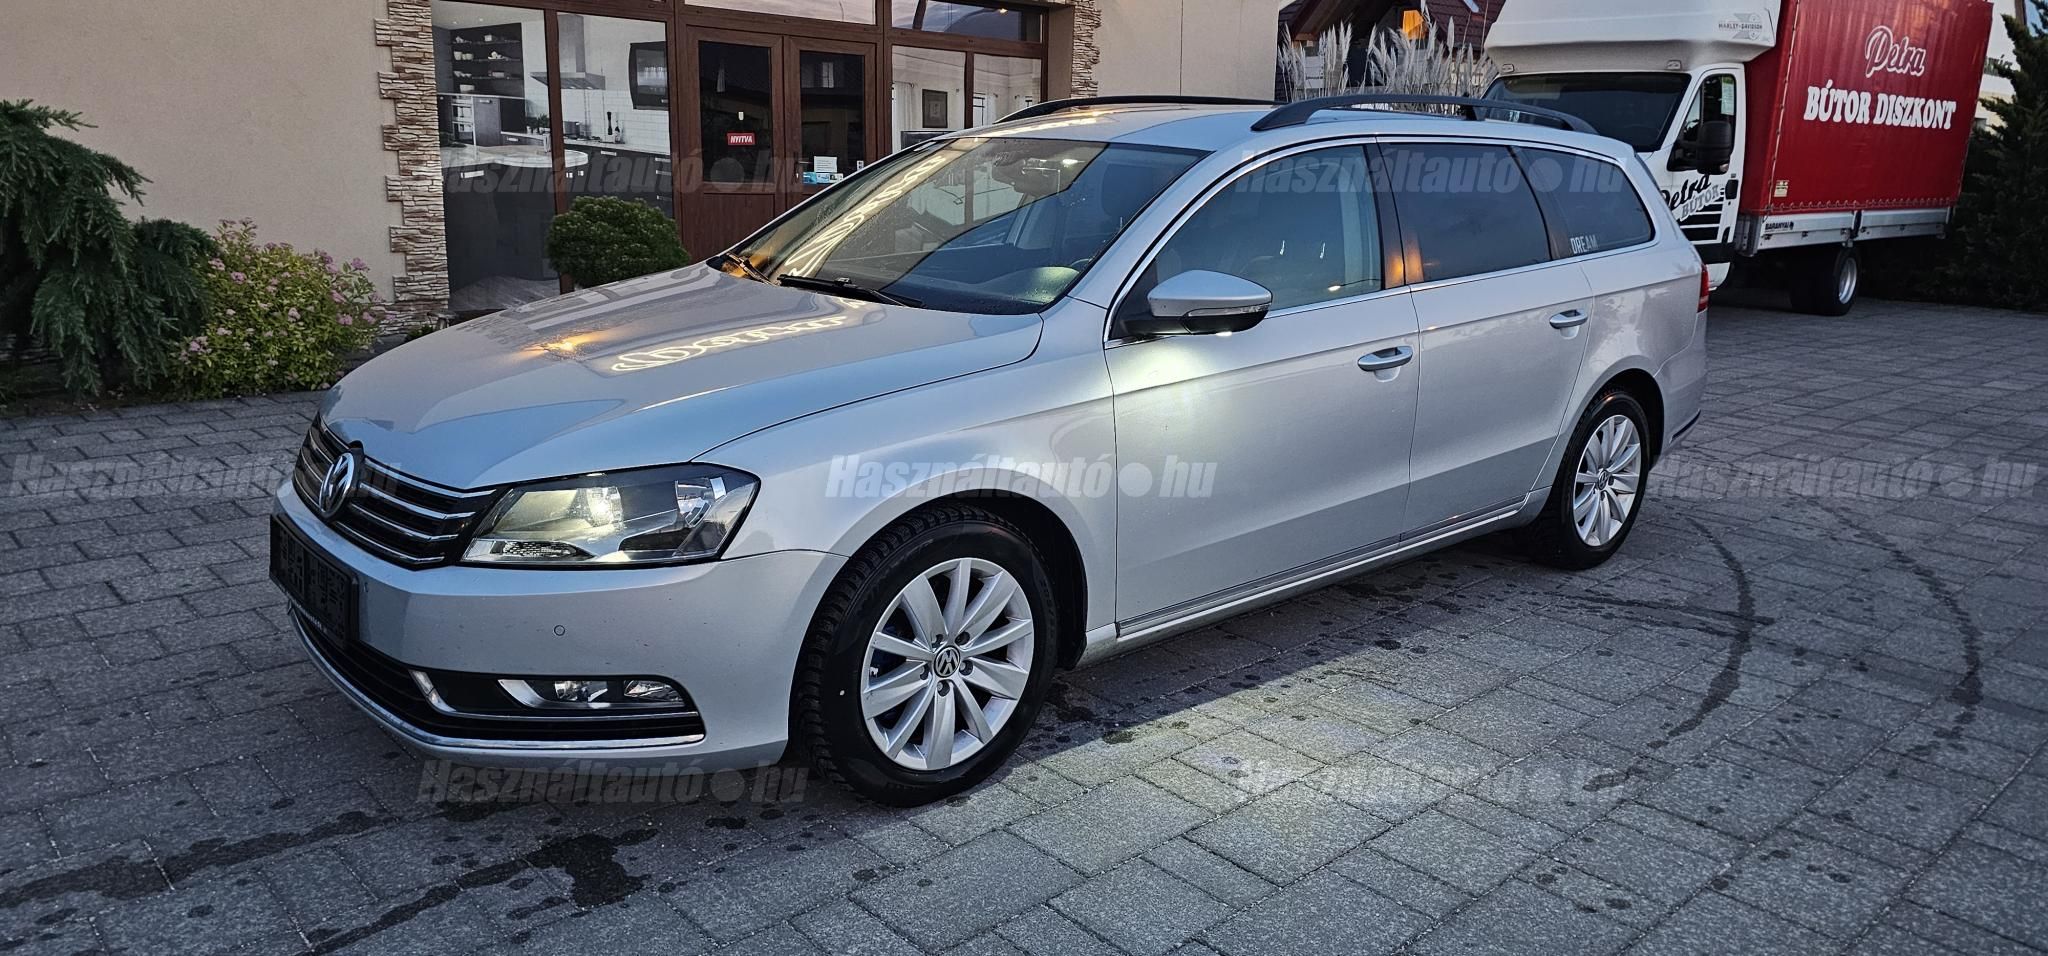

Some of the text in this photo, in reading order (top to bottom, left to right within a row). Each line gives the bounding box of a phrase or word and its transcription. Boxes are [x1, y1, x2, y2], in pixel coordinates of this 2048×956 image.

[1865, 25, 1926, 78] Petra
[1803, 79, 1957, 130] BÚTOR DISZKONT
[730, 135, 753, 144] NYITVA
[1681, 184, 1720, 218] BÚTOR
